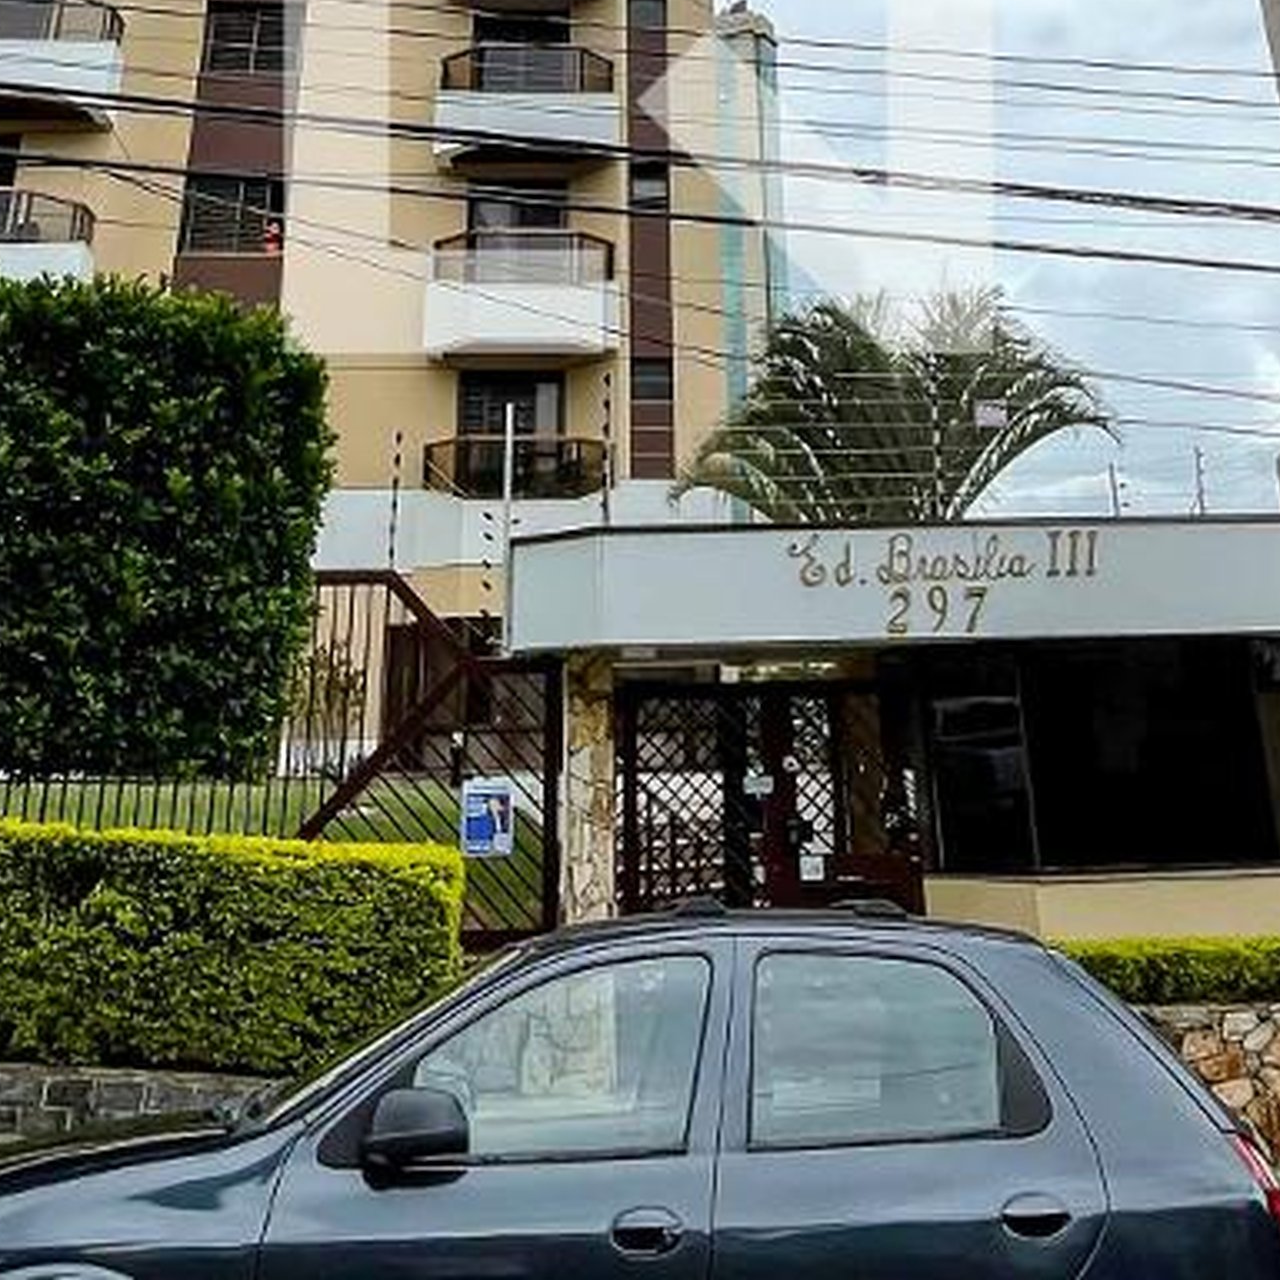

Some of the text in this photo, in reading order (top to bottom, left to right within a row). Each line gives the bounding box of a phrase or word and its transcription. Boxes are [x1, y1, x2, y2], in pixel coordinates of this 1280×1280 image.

[787, 532, 868, 587] Ed.
[1046, 530, 1099, 577] III
[885, 584, 989, 634] 297
